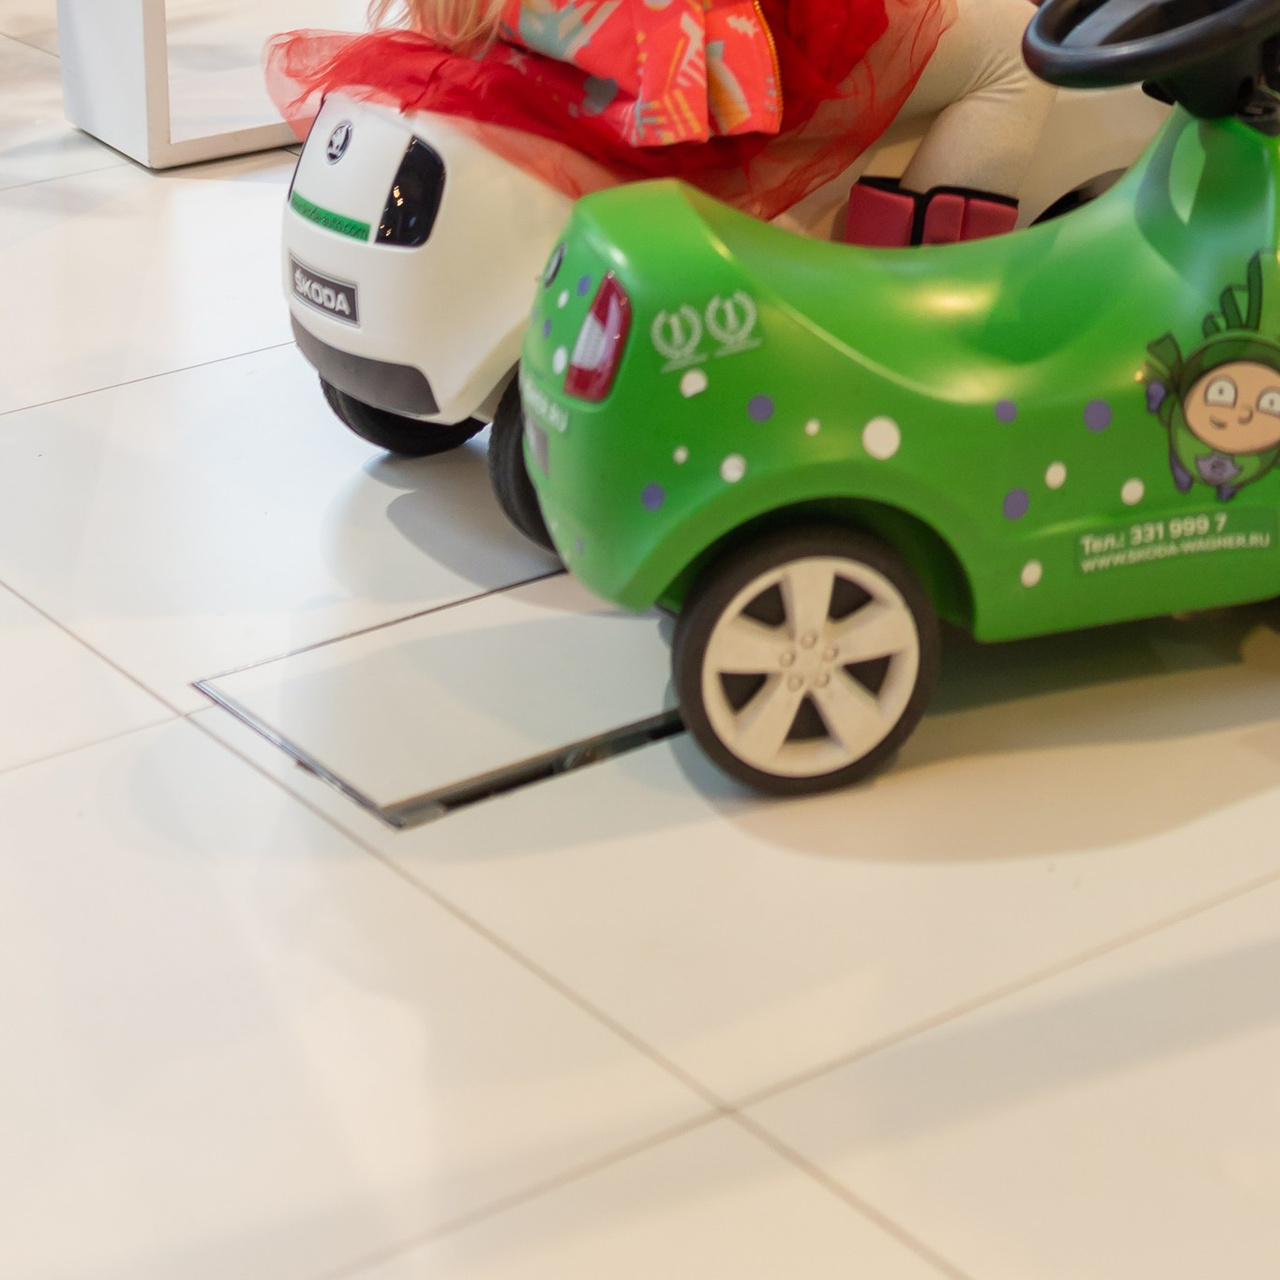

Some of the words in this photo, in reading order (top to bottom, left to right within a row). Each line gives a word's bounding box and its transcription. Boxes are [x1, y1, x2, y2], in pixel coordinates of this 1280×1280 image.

[294, 269, 350, 315] ŠKODA
[1130, 523, 1164, 546] 331
[1169, 514, 1210, 539] 999
[1214, 512, 1228, 534] 7
